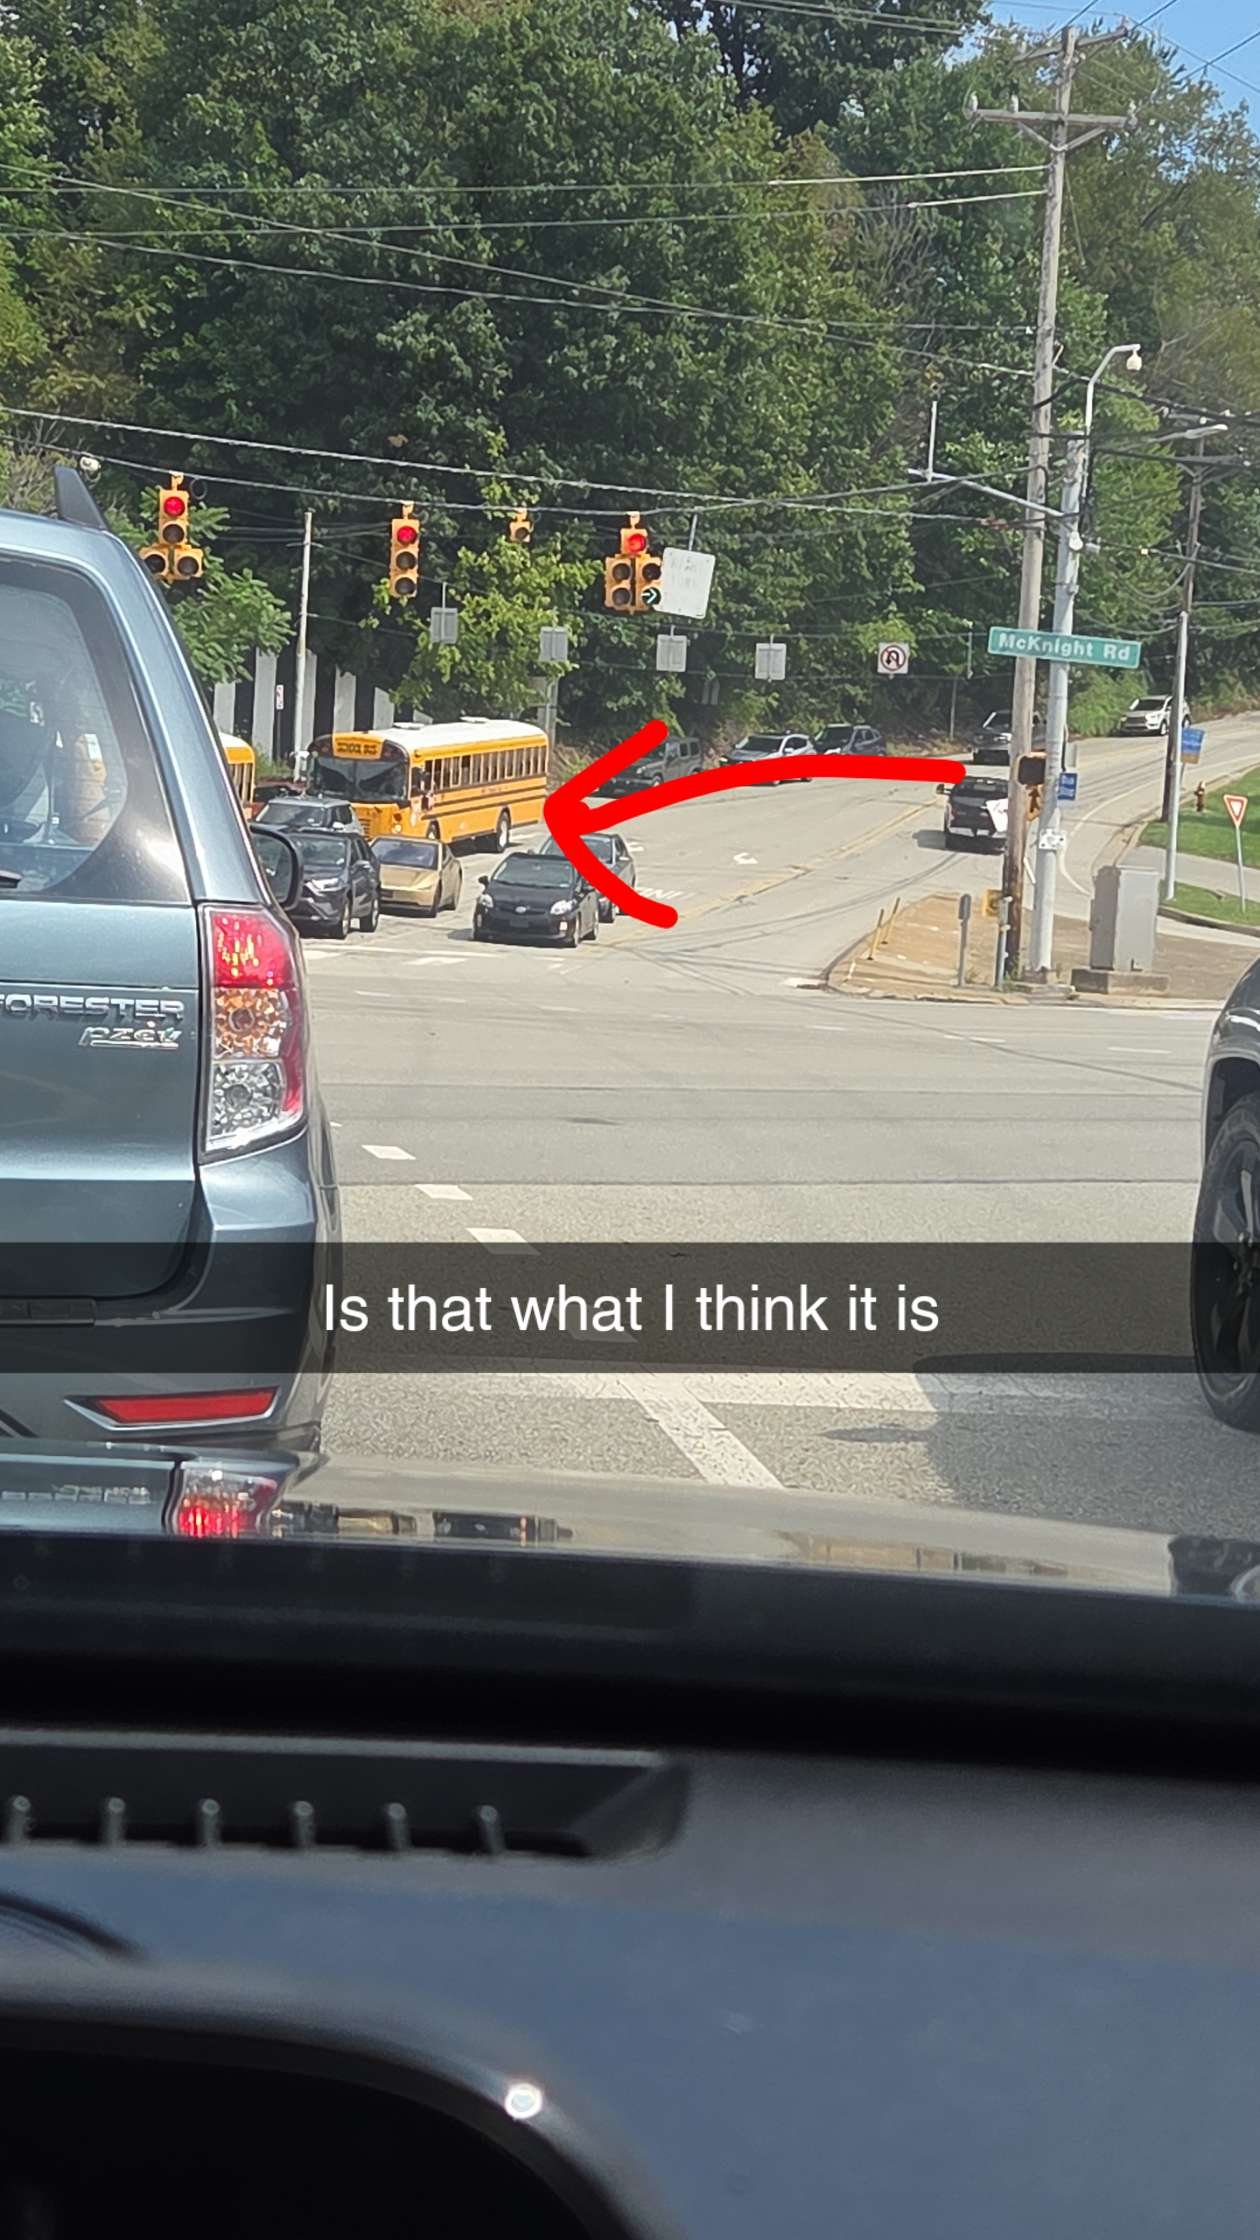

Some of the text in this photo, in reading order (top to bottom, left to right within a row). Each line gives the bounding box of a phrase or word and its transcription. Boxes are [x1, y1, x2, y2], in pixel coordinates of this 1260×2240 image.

[998, 632, 1131, 661] McKnight Rd
[0, 993, 185, 1020] ORESTER
